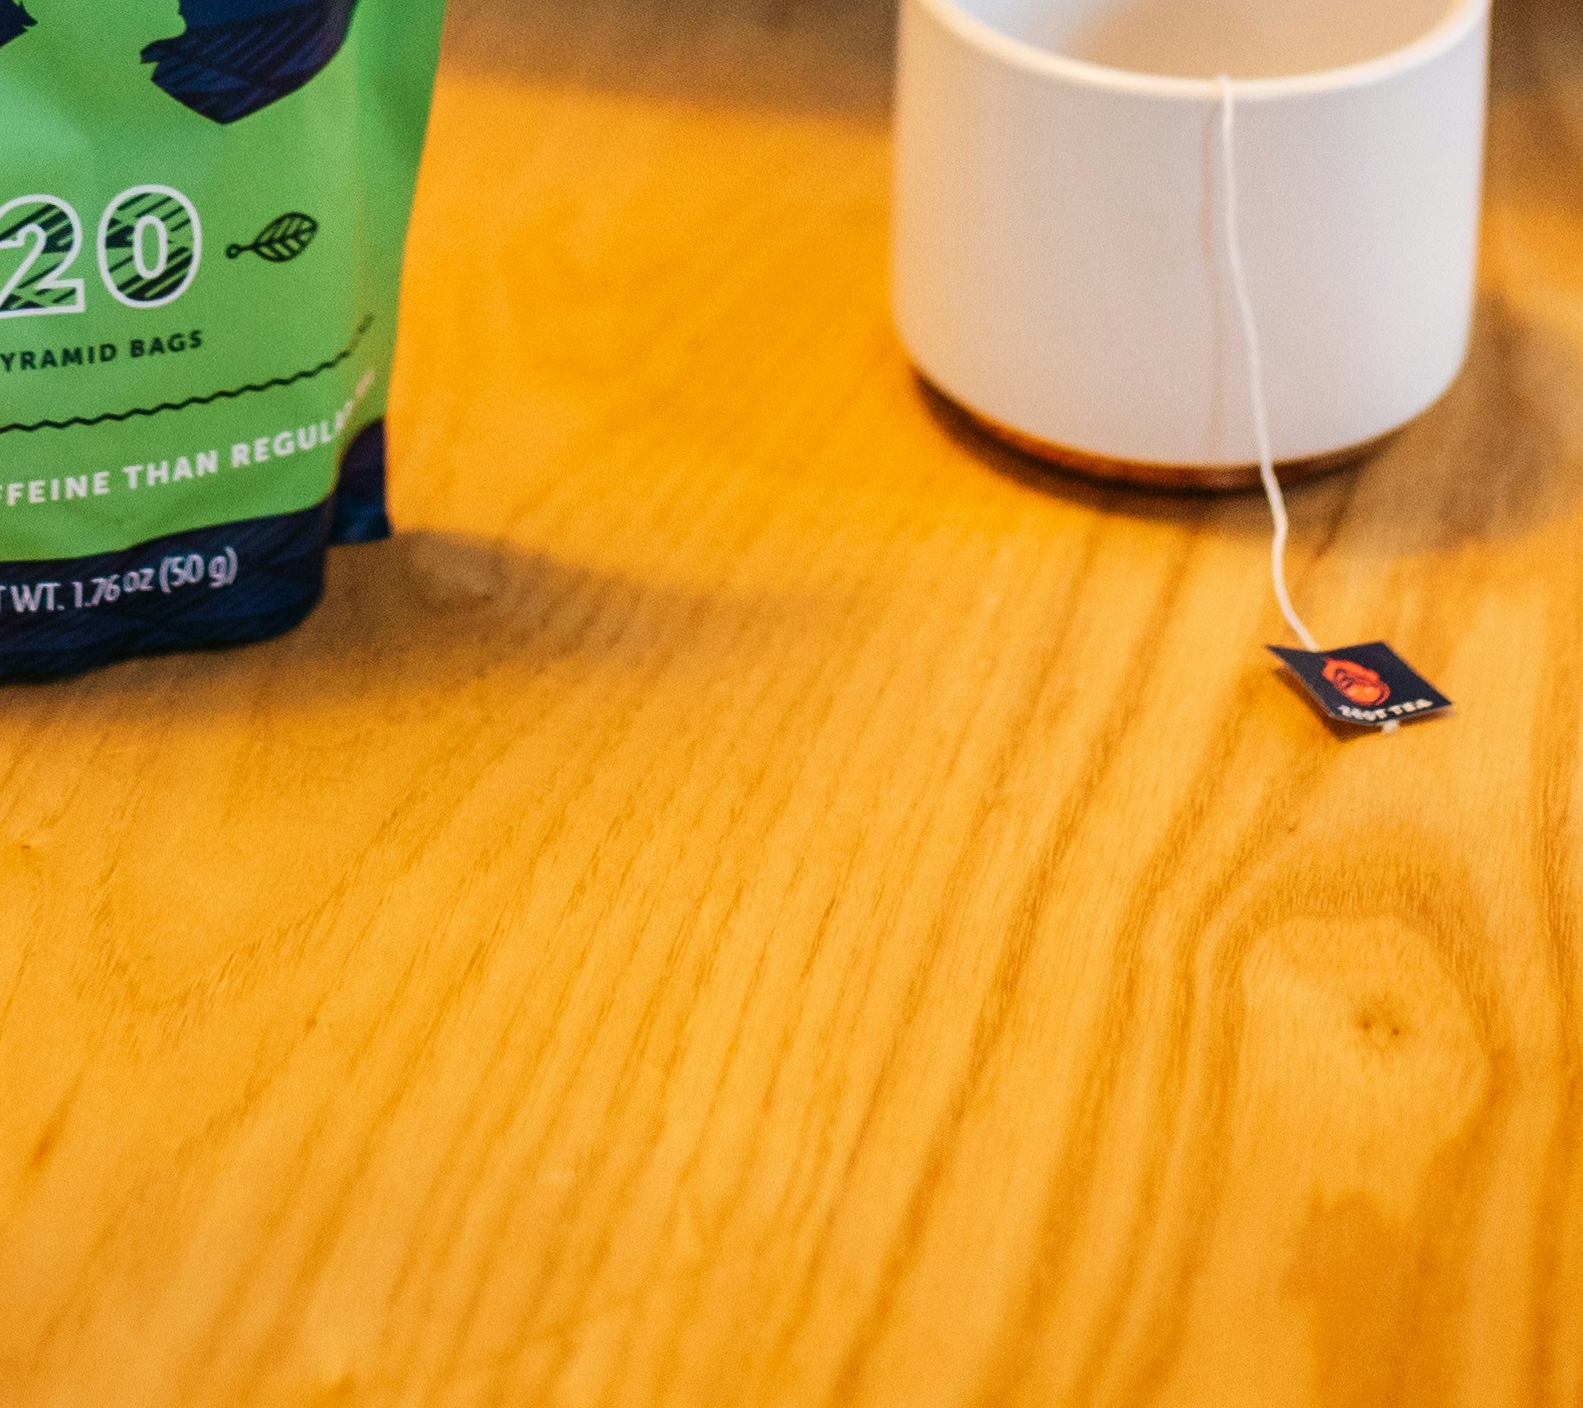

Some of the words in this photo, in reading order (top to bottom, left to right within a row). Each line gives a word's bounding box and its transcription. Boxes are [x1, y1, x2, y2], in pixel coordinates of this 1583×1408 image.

[129, 330, 203, 358] BAGS
[122, 449, 219, 490] THAN
[10, 582, 65, 613] WT.
